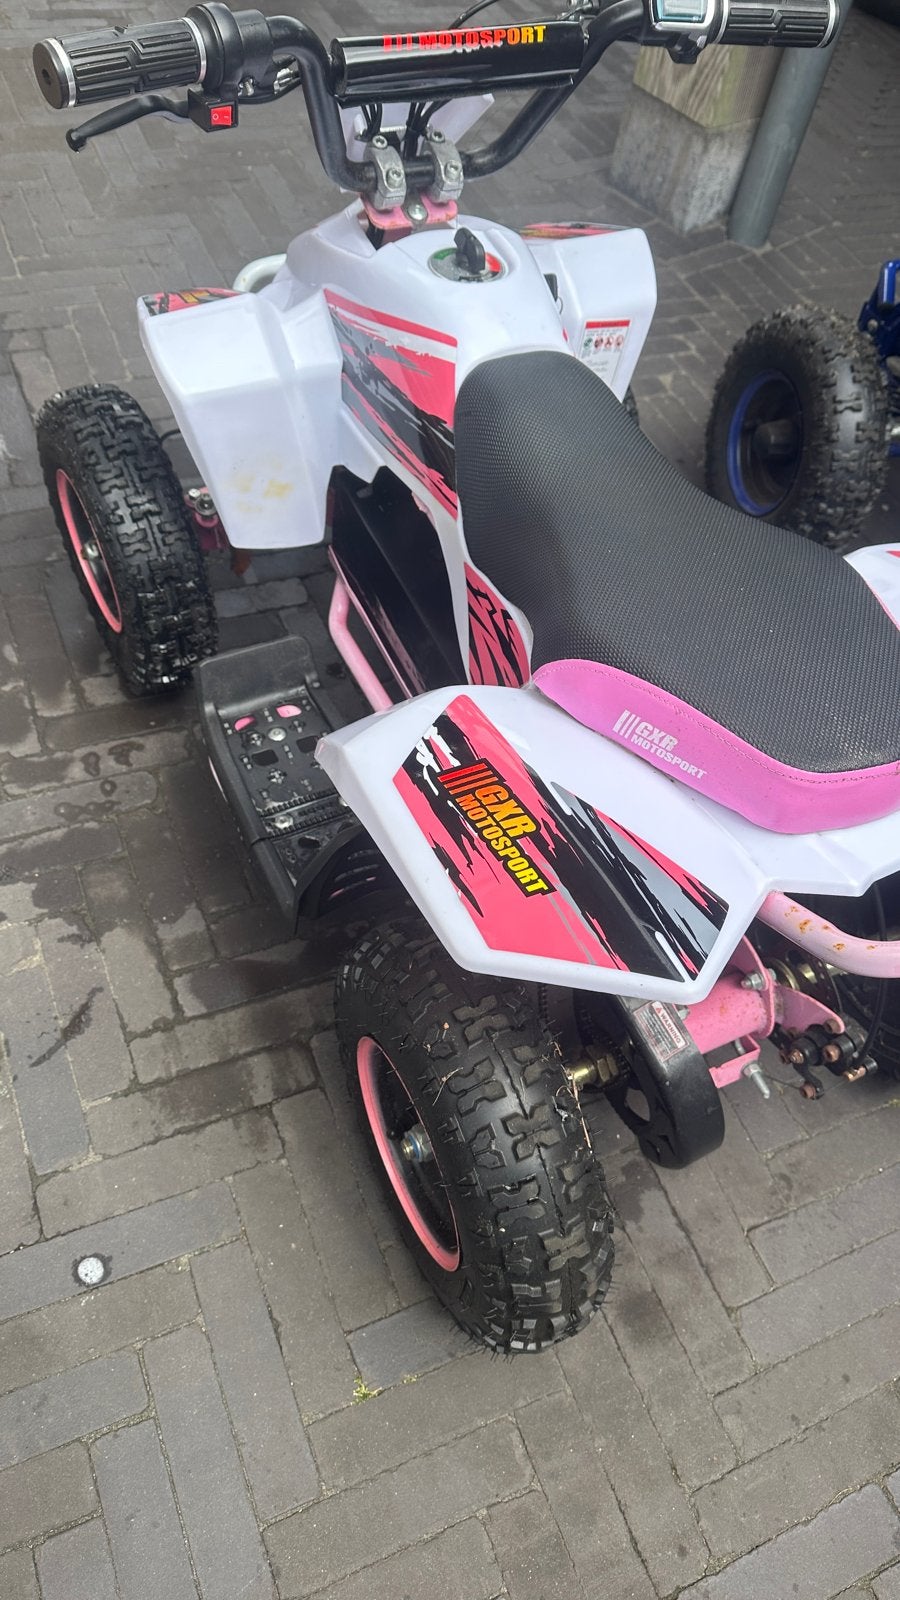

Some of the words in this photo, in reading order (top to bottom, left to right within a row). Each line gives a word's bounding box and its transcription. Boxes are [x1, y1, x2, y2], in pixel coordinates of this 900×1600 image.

[419, 25, 547, 50] MOTOSPORT
[634, 721, 679, 751] GXR
[630, 734, 708, 779] MOTOSPORT
[474, 784, 537, 838] GXR
[455, 793, 549, 893] MOTOSPORT
[660, 1013, 681, 1044] WARNING
